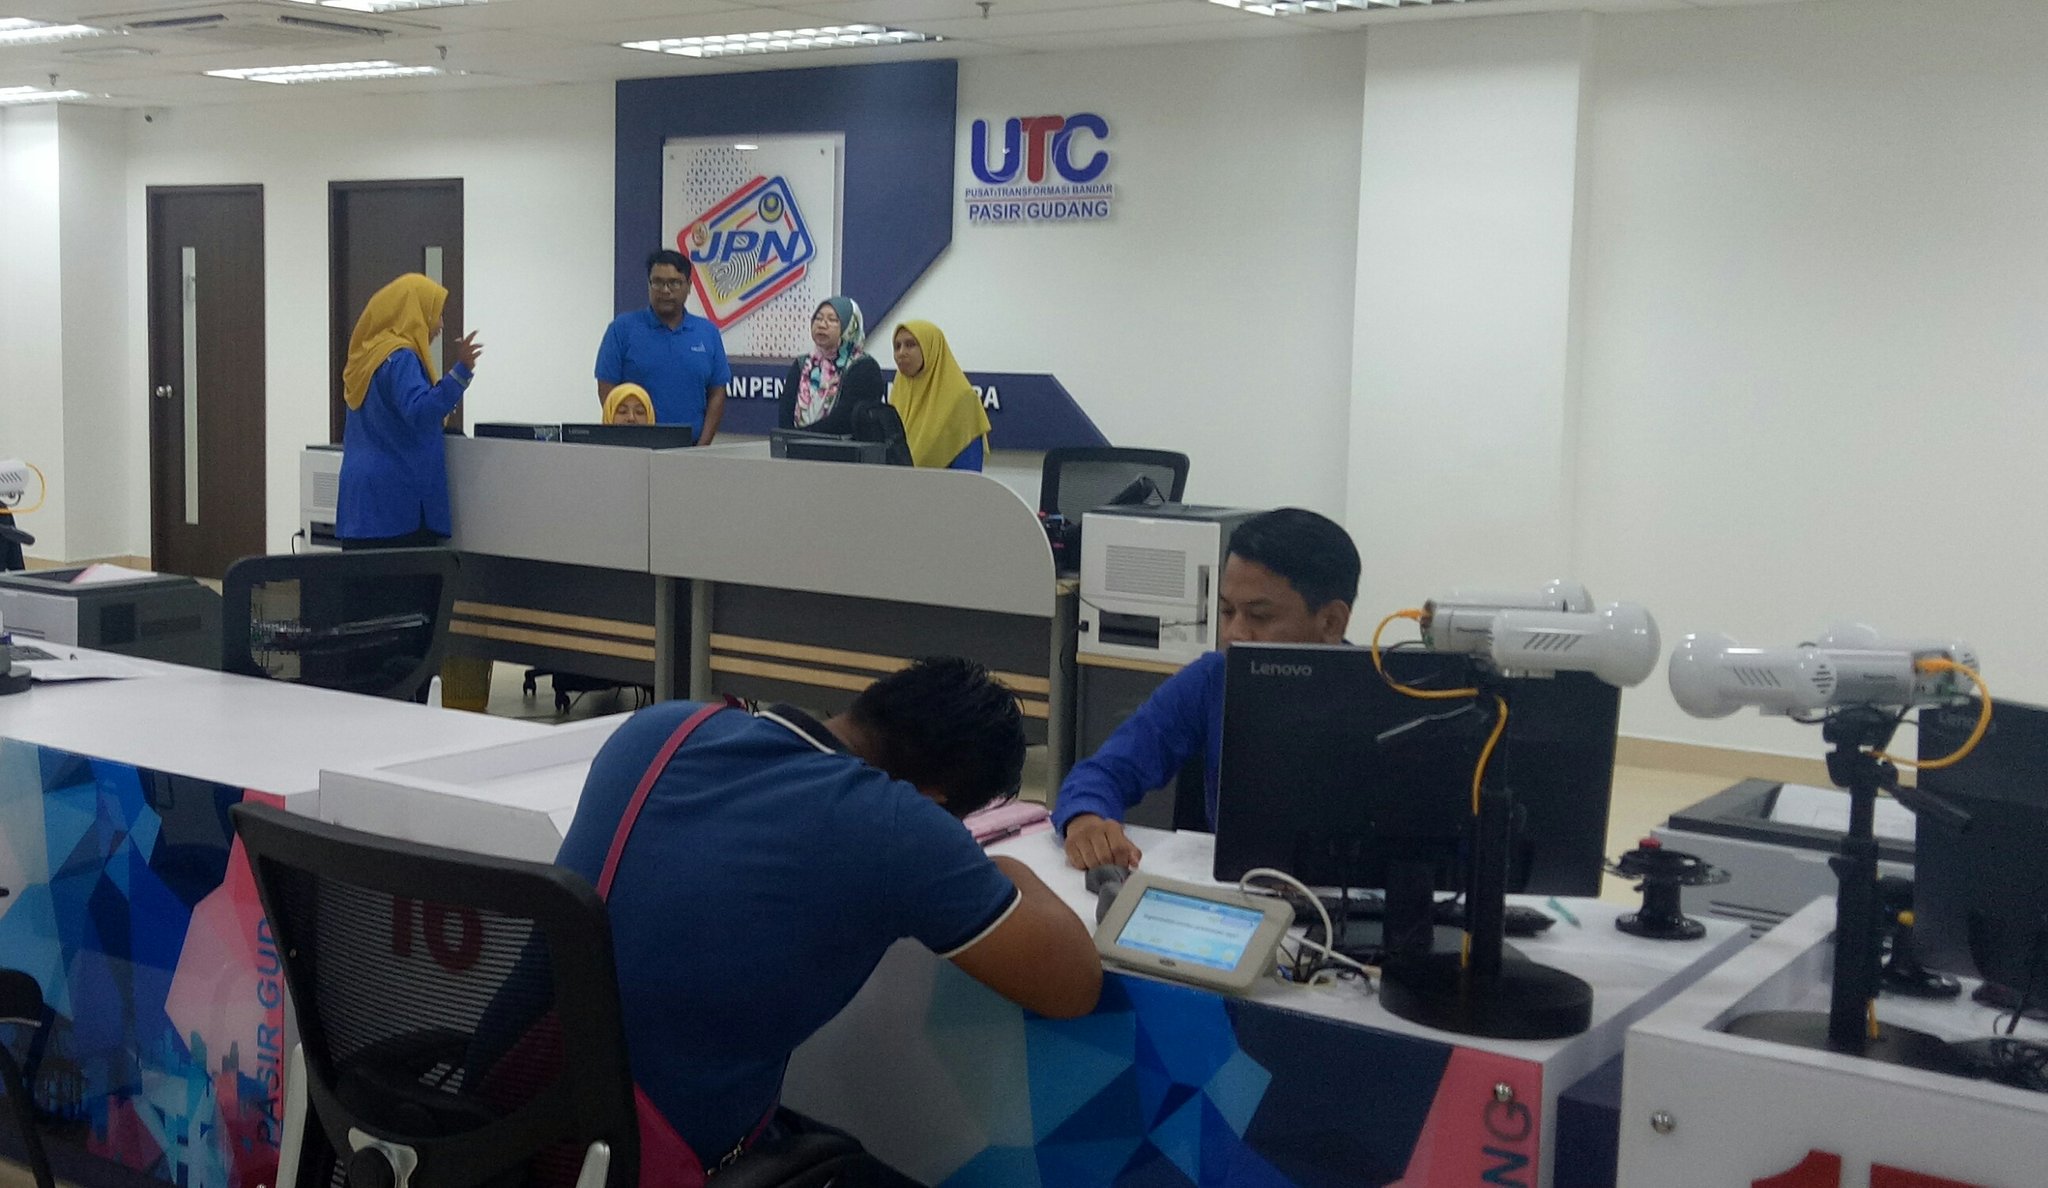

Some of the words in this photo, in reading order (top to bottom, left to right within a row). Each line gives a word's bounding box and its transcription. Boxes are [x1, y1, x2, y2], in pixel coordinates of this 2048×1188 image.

[971, 113, 1109, 184] UTC
[965, 187, 994, 198] PUSAT
[996, 185, 1070, 197] TRANSFORMASI
[1072, 183, 1113, 195] BANDAR
[969, 203, 1021, 220] PASIR
[1027, 201, 1108, 219] GUDANG
[690, 230, 800, 263] JPN
[1250, 660, 1313, 677] Lenovo
